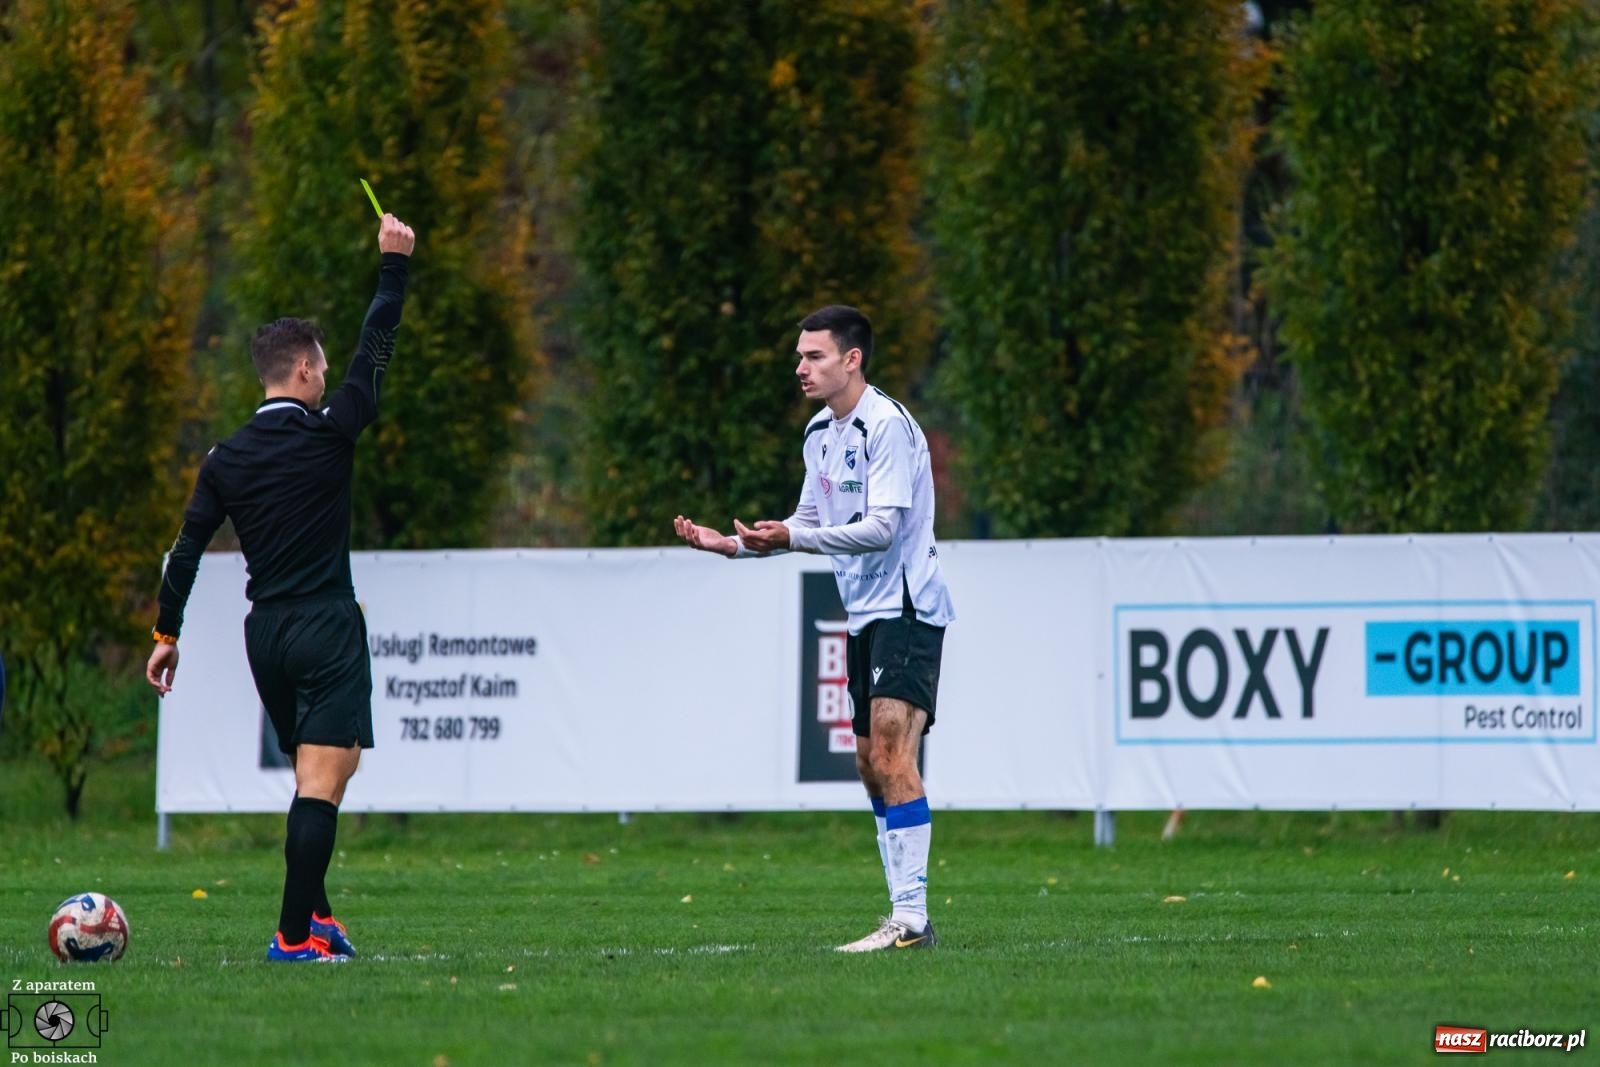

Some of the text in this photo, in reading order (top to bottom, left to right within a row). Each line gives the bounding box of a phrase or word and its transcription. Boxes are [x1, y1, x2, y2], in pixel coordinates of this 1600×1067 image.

[369, 632, 538, 664] Usługi Remontowe
[1127, 627, 1330, 719] BOXY
[385, 673, 518, 706] Krzysztof Kaim
[400, 716, 501, 740] 782 680 799
[1464, 704, 1583, 730] Pest Control
